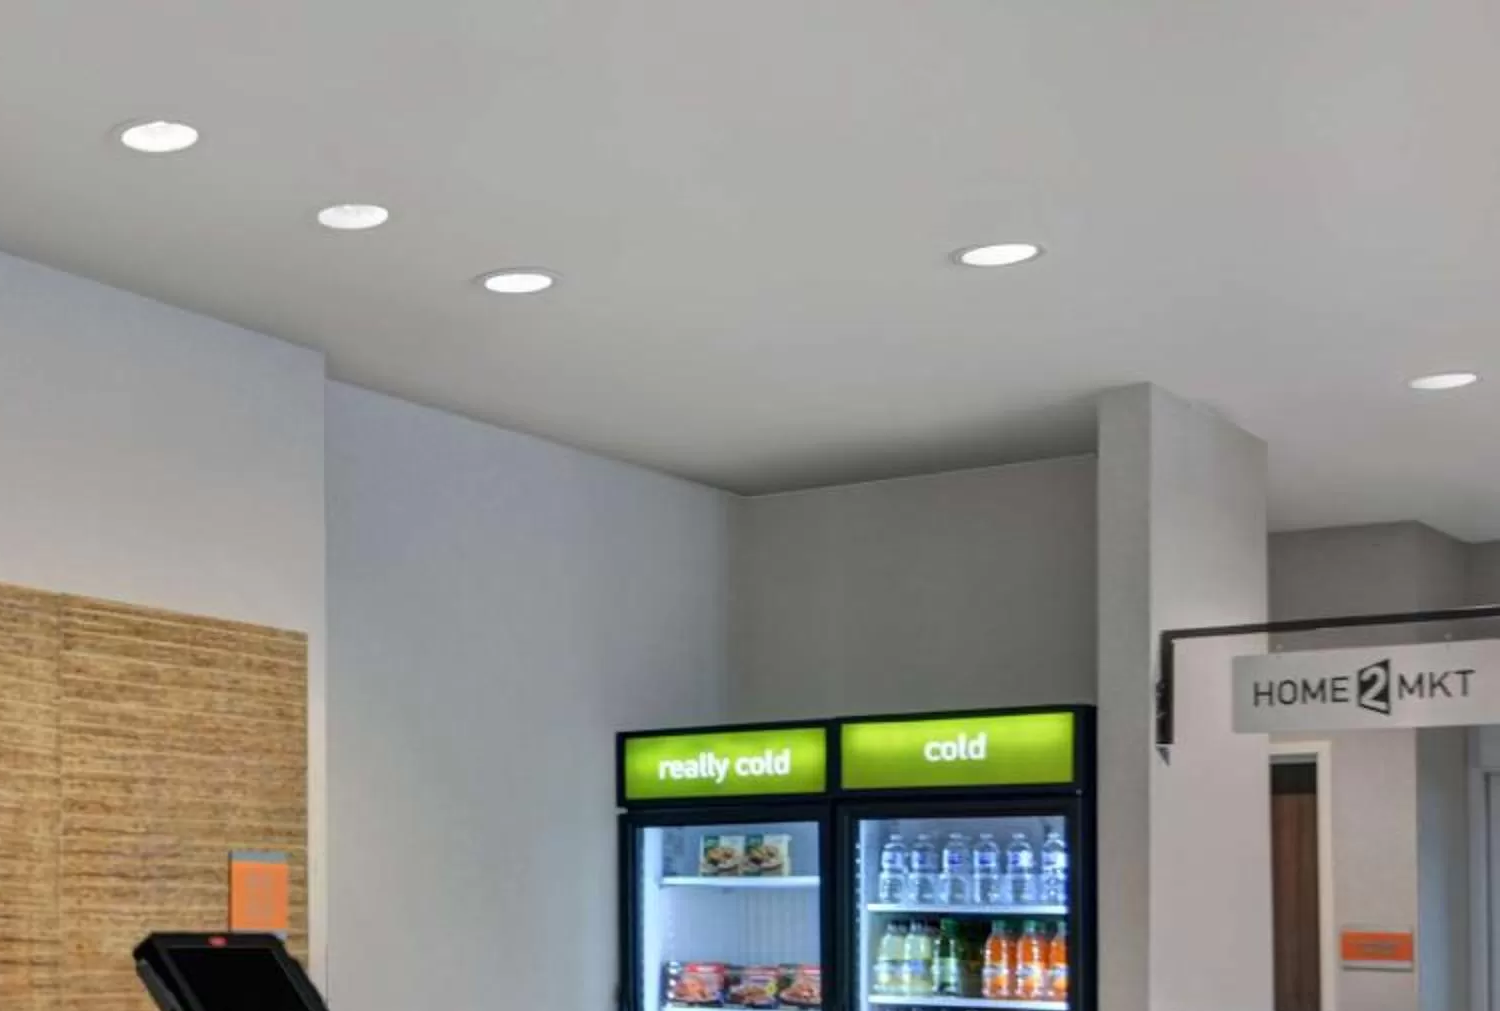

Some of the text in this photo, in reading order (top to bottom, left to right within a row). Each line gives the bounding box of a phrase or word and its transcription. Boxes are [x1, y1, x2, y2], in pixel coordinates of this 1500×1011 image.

[924, 731, 987, 762] cold
[658, 748, 791, 784] really cold
